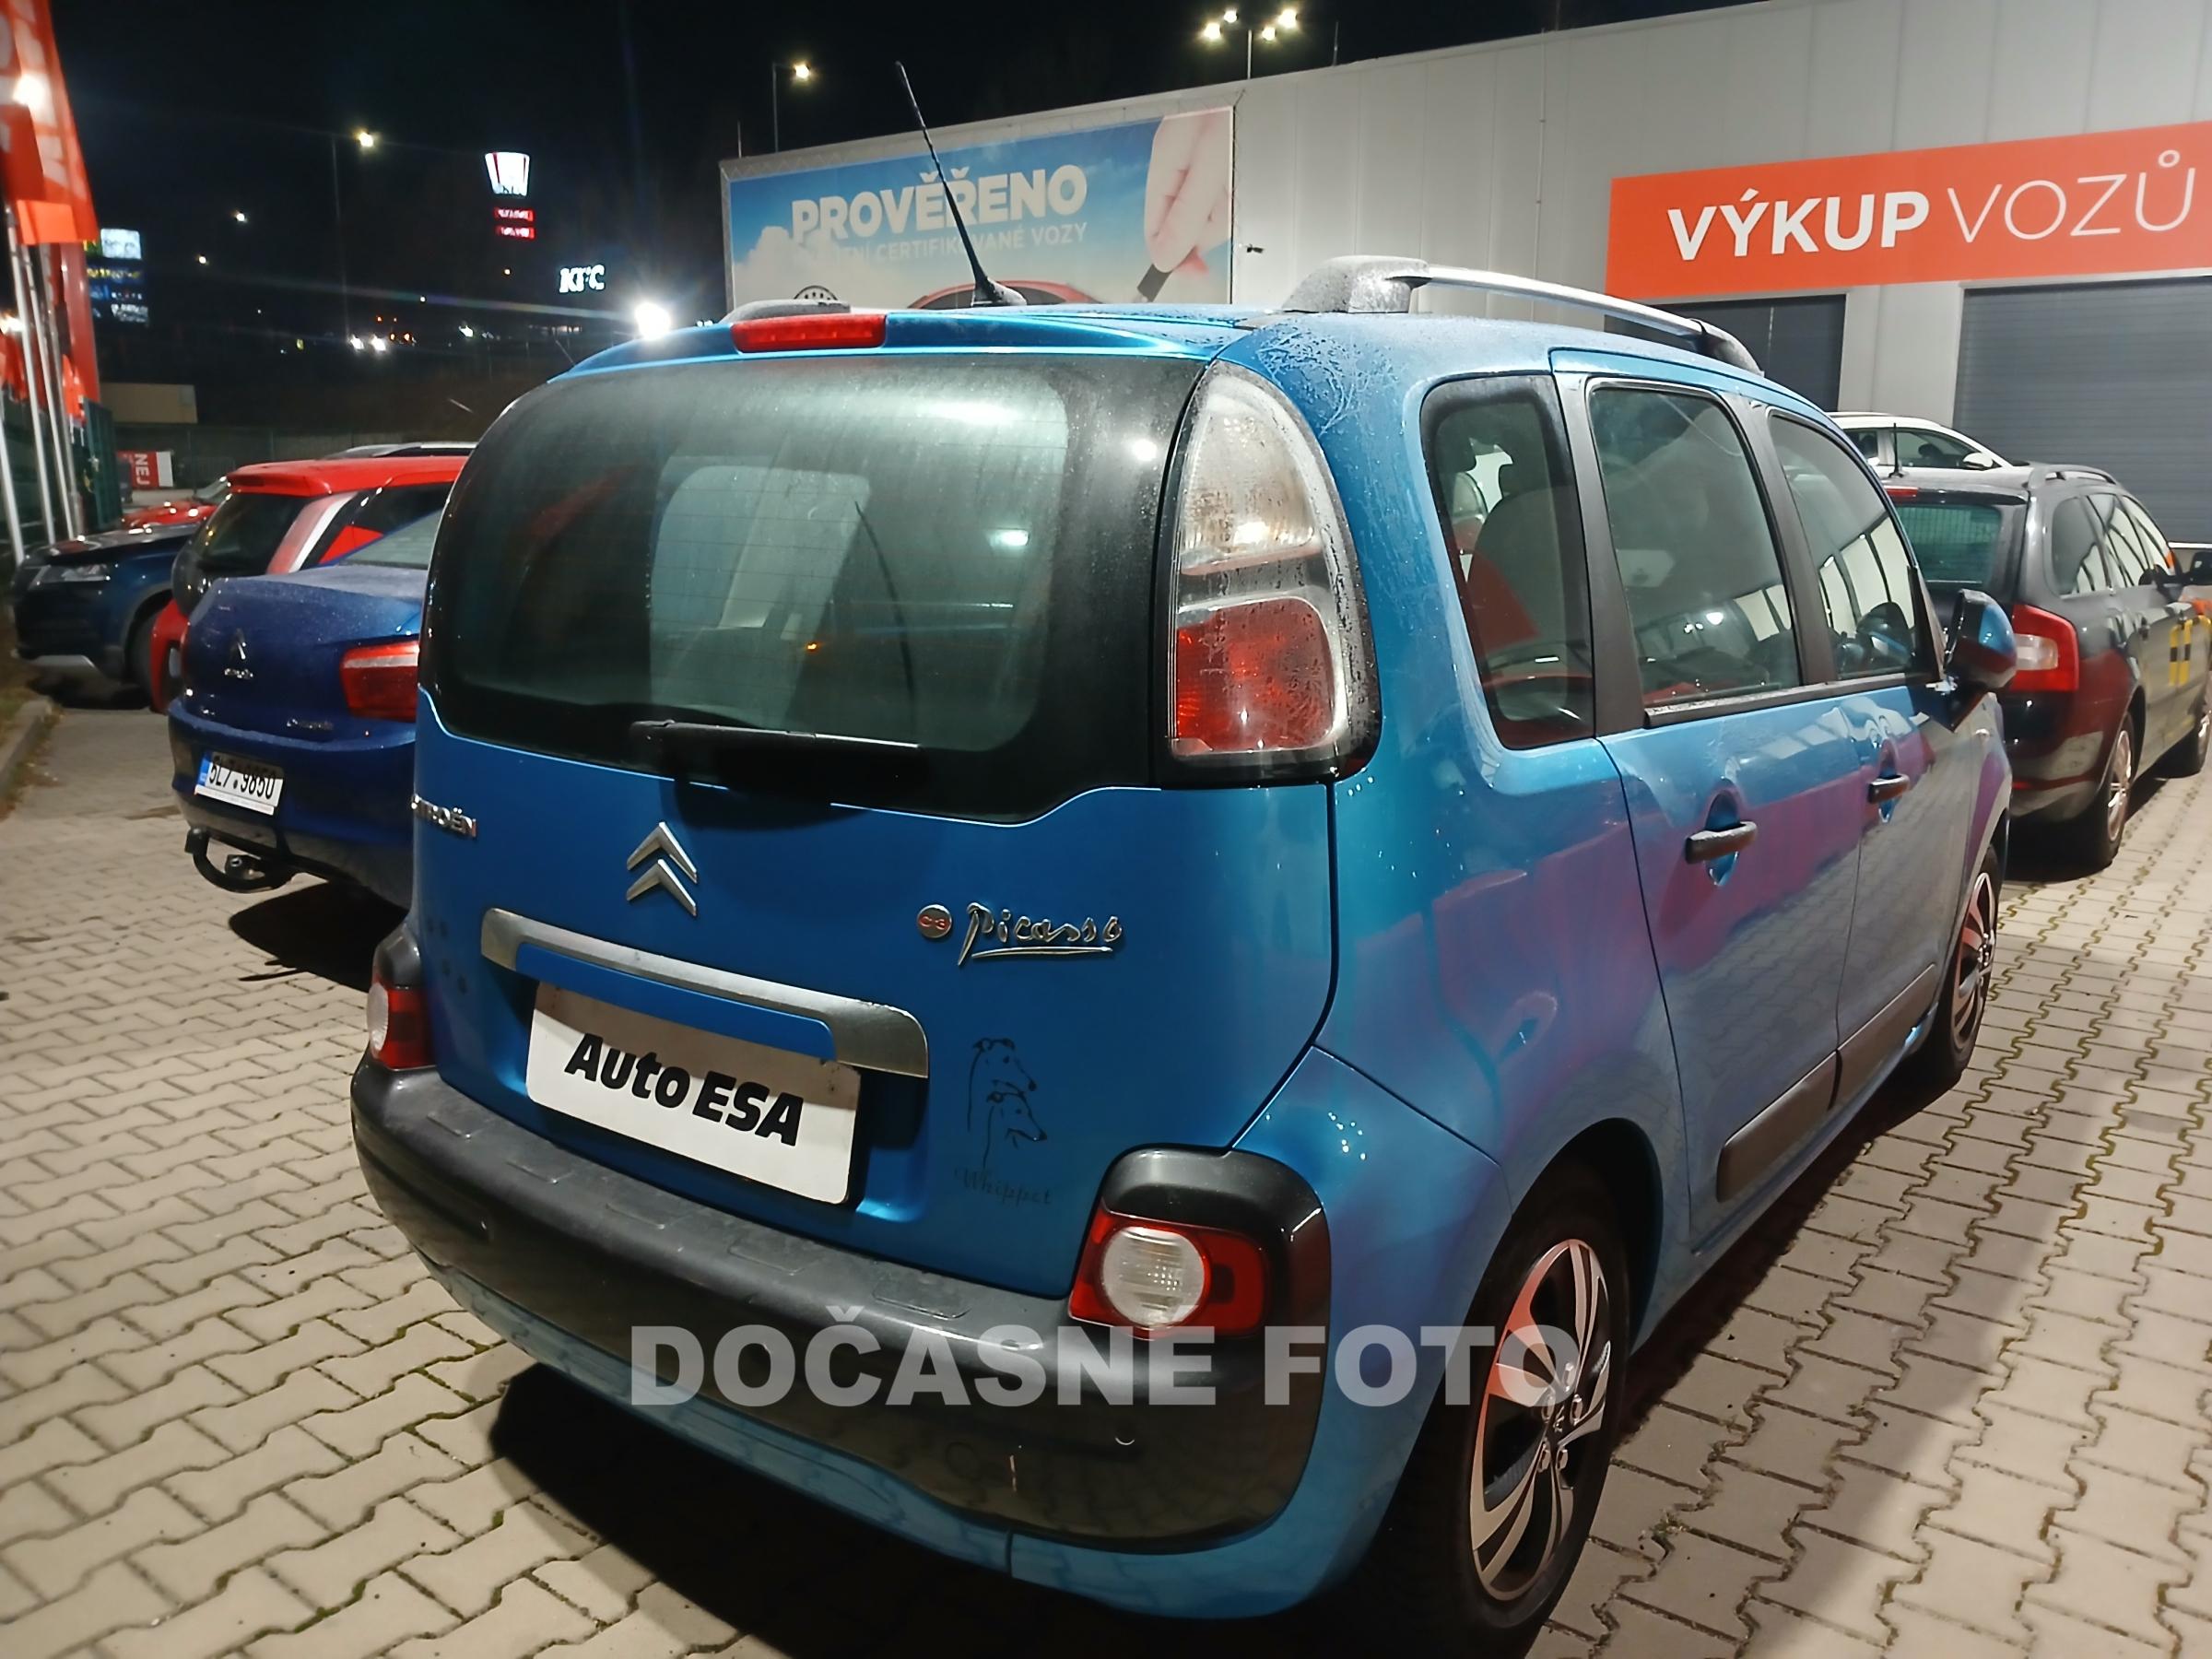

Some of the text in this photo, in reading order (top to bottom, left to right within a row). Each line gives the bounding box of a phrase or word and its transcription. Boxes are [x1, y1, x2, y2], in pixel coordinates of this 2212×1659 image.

[792, 165, 1088, 245] PROVĚŘENO
[1031, 222, 1088, 247] VOZY
[1667, 149, 2195, 261] VÝKUP VOZŮ
[559, 264, 606, 294] KFC
[958, 902, 1123, 966] Picasso
[564, 1032, 804, 1147] Auto ESA
